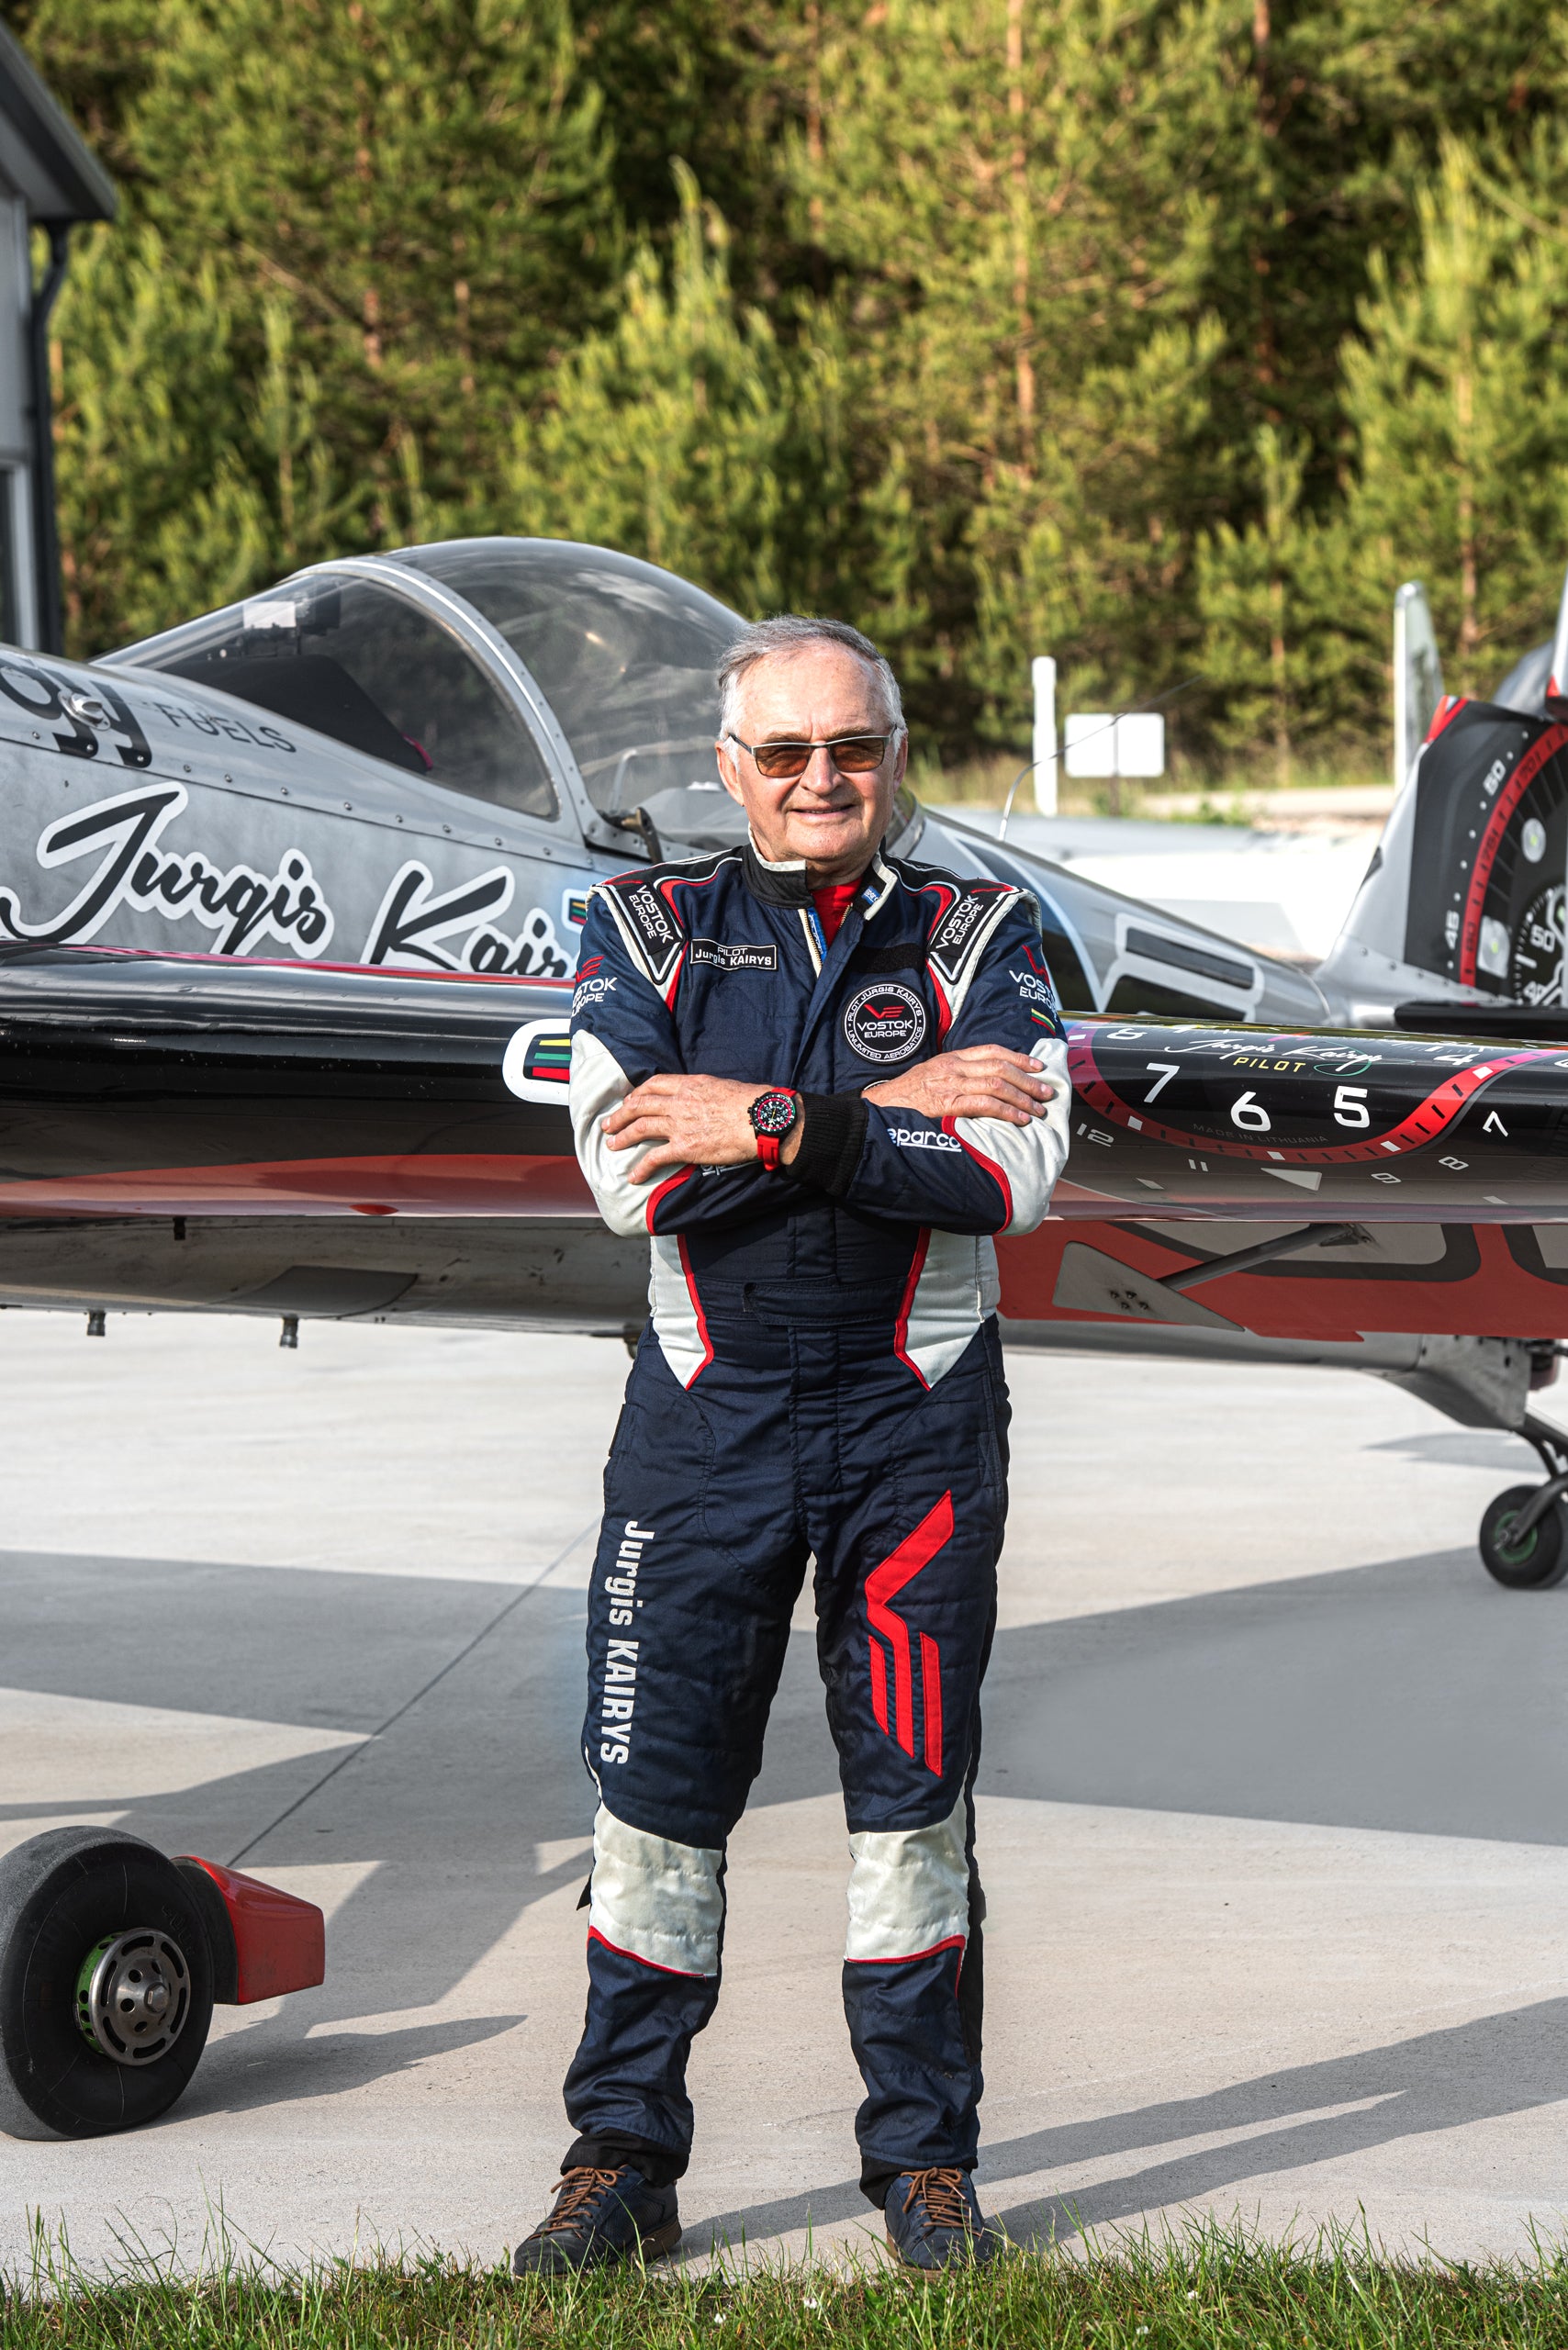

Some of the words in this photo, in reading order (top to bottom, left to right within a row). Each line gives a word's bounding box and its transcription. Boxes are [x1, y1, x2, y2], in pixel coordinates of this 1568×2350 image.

[153, 701, 297, 753] FUELS
[629, 894, 657, 939] EUROPE
[637, 884, 674, 944] VOSTOK
[935, 893, 979, 949] VOSTOK
[952, 903, 983, 945] EUROPE
[695, 948, 725, 965] Jurgis
[730, 954, 772, 966] KAIRYS
[718, 946, 747, 957] PILOT
[847, 1000, 860, 1022] PILOT
[860, 986, 894, 1001] JURGIS
[896, 988, 923, 1017] KAIRYS
[847, 1029, 881, 1059] UNLIMITED
[883, 1026, 923, 1059] AEROBATICS
[857, 1020, 913, 1031] VOSTOK
[864, 1030, 906, 1038] EUROPE
[1233, 1057, 1306, 1073] PILOT
[1433, 1053, 1480, 1066] 4
[1143, 1062, 1181, 1102] 7
[1230, 1091, 1271, 1132] 6
[1333, 1085, 1370, 1128] 5
[1483, 1110, 1509, 1137] 7
[1076, 1123, 1114, 1147] 12
[1193, 1123, 1235, 1138] MADE
[1239, 1133, 1253, 1141] IN
[1258, 1135, 1329, 1144] LITHUANIA
[1439, 1156, 1469, 1170] 8
[603, 1520, 655, 1628] Jurgis
[599, 1639, 640, 1765] KAIRYS
